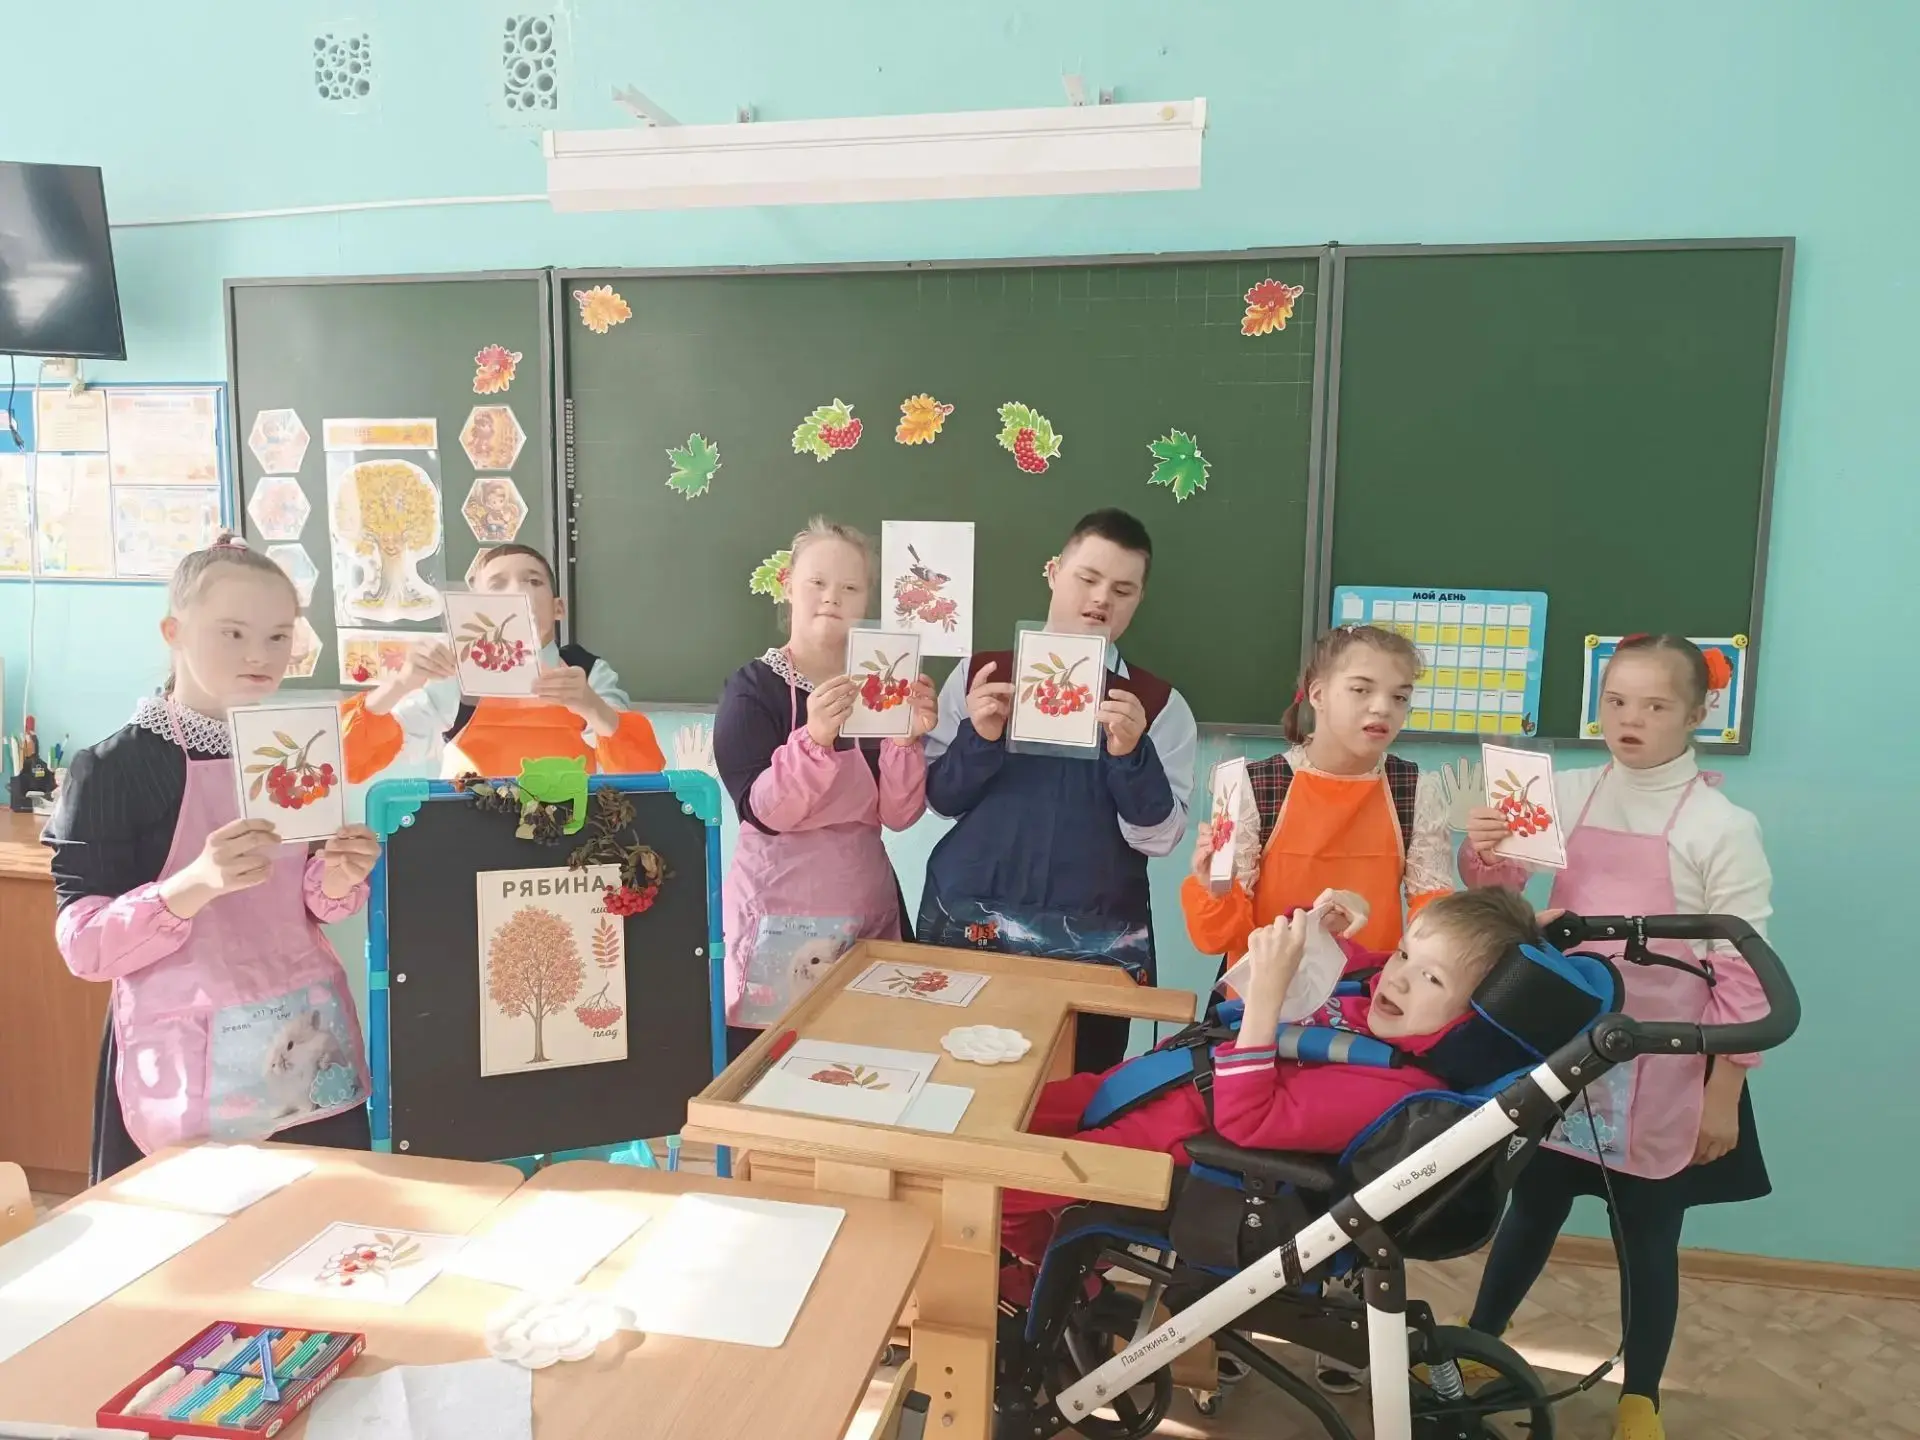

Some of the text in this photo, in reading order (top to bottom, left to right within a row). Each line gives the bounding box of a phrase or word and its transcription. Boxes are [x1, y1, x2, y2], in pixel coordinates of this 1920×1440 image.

[1412, 590, 1466, 602] МОЙ ДЕНЬ
[502, 875, 607, 899] РЯБИНА
[592, 1029, 618, 1040] плод
[1410, 1160, 1438, 1181] Buggy
[1120, 1327, 1179, 1367] Палаткина В.
